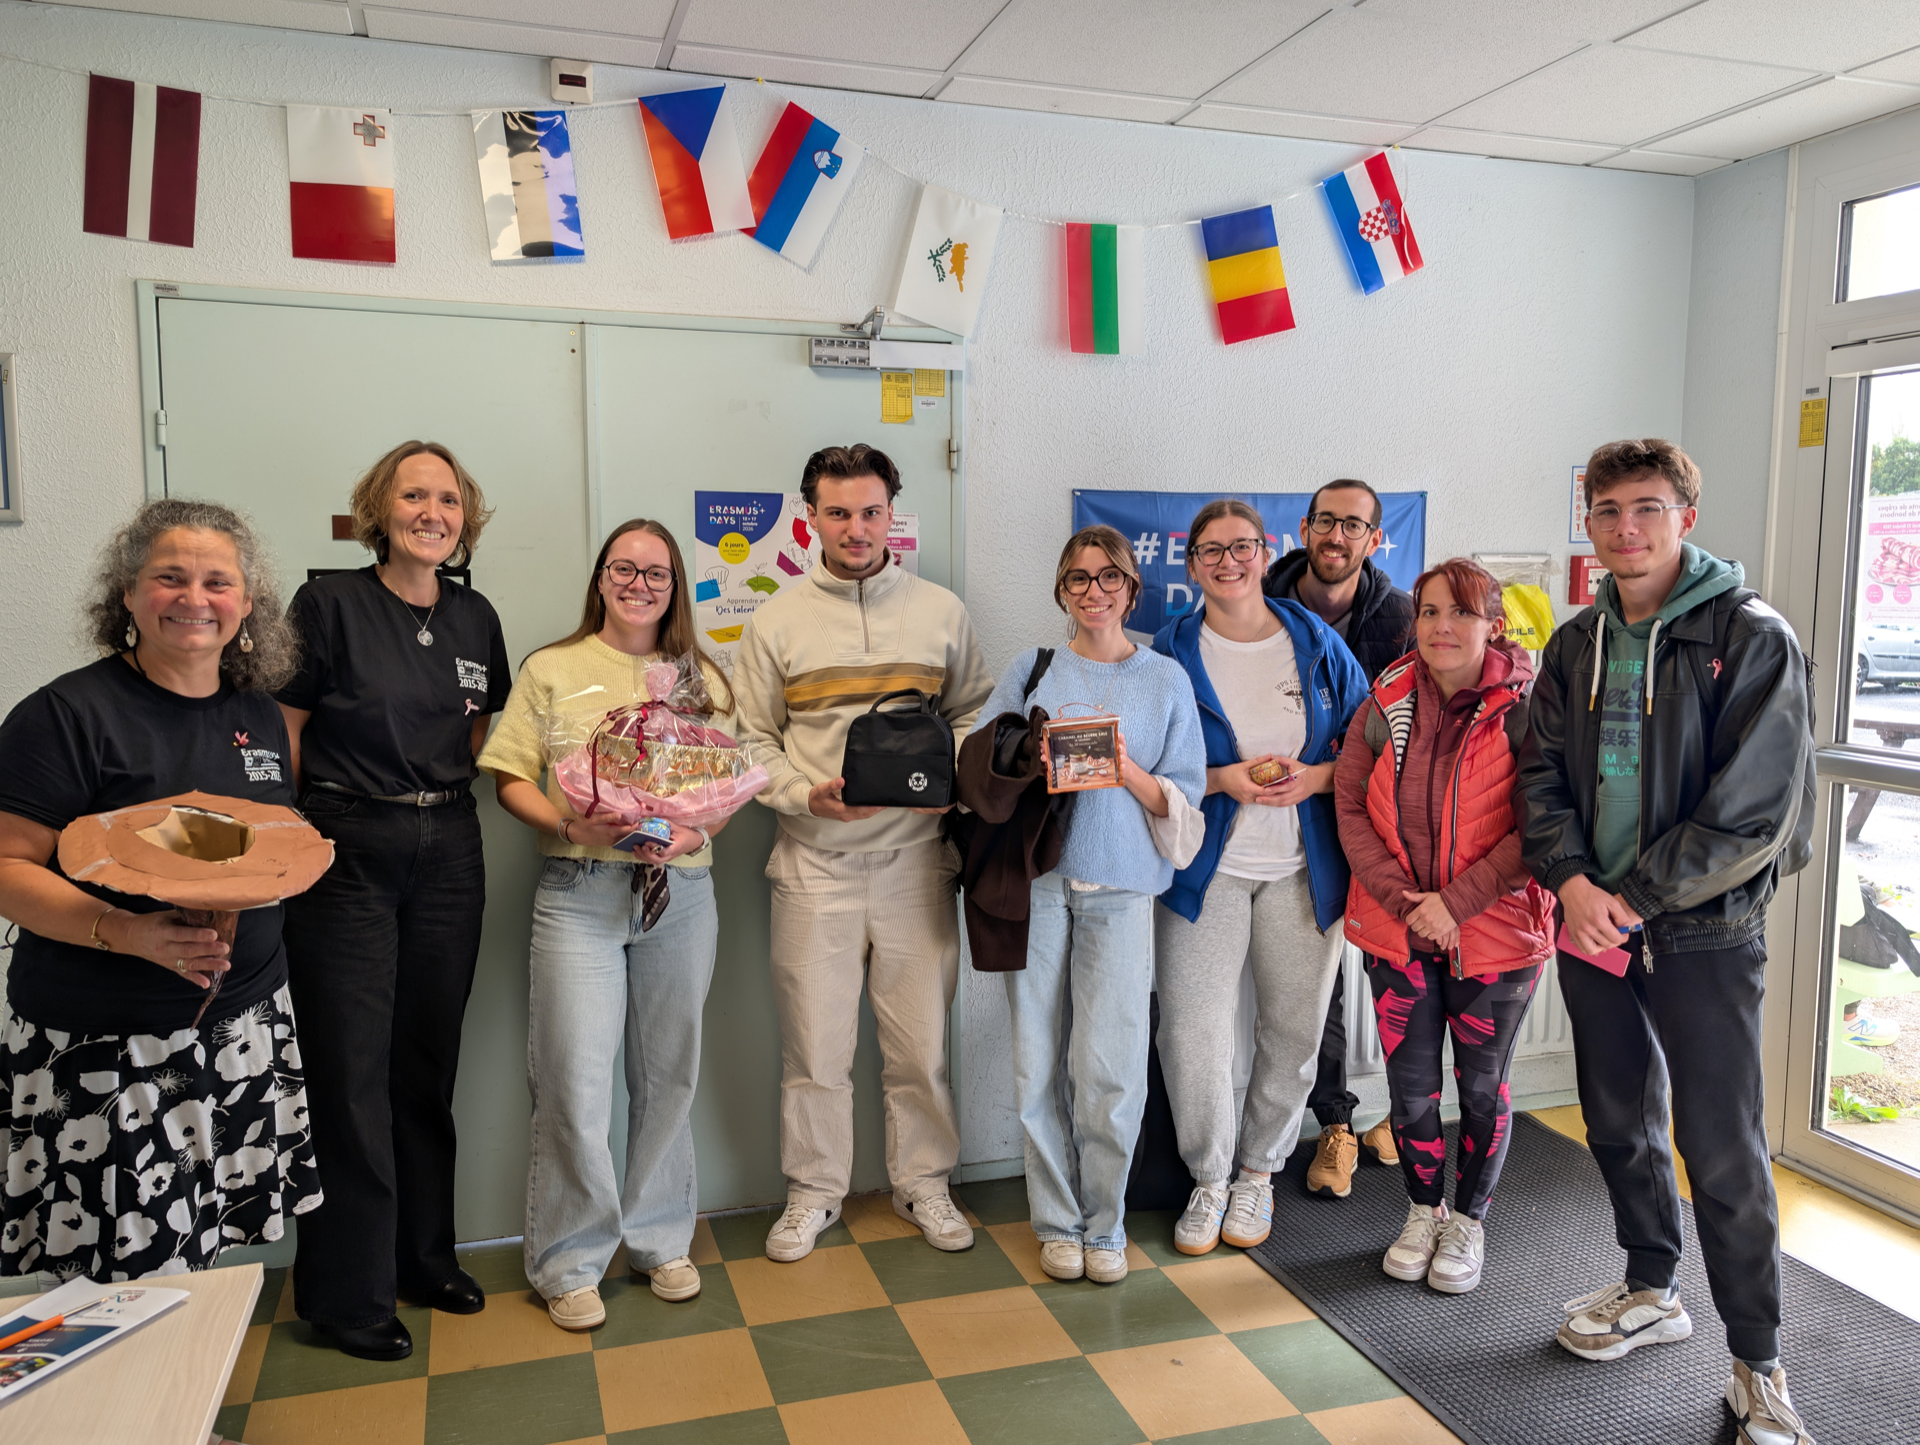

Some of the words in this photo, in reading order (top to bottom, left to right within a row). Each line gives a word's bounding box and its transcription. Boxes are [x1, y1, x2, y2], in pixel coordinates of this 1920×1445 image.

[709, 516, 736, 525] DAYS
[892, 519, 907, 527] êpes
[716, 605, 731, 615] Des
[733, 605, 756, 615] talent
[1599, 726, 1640, 748] 娱乐
